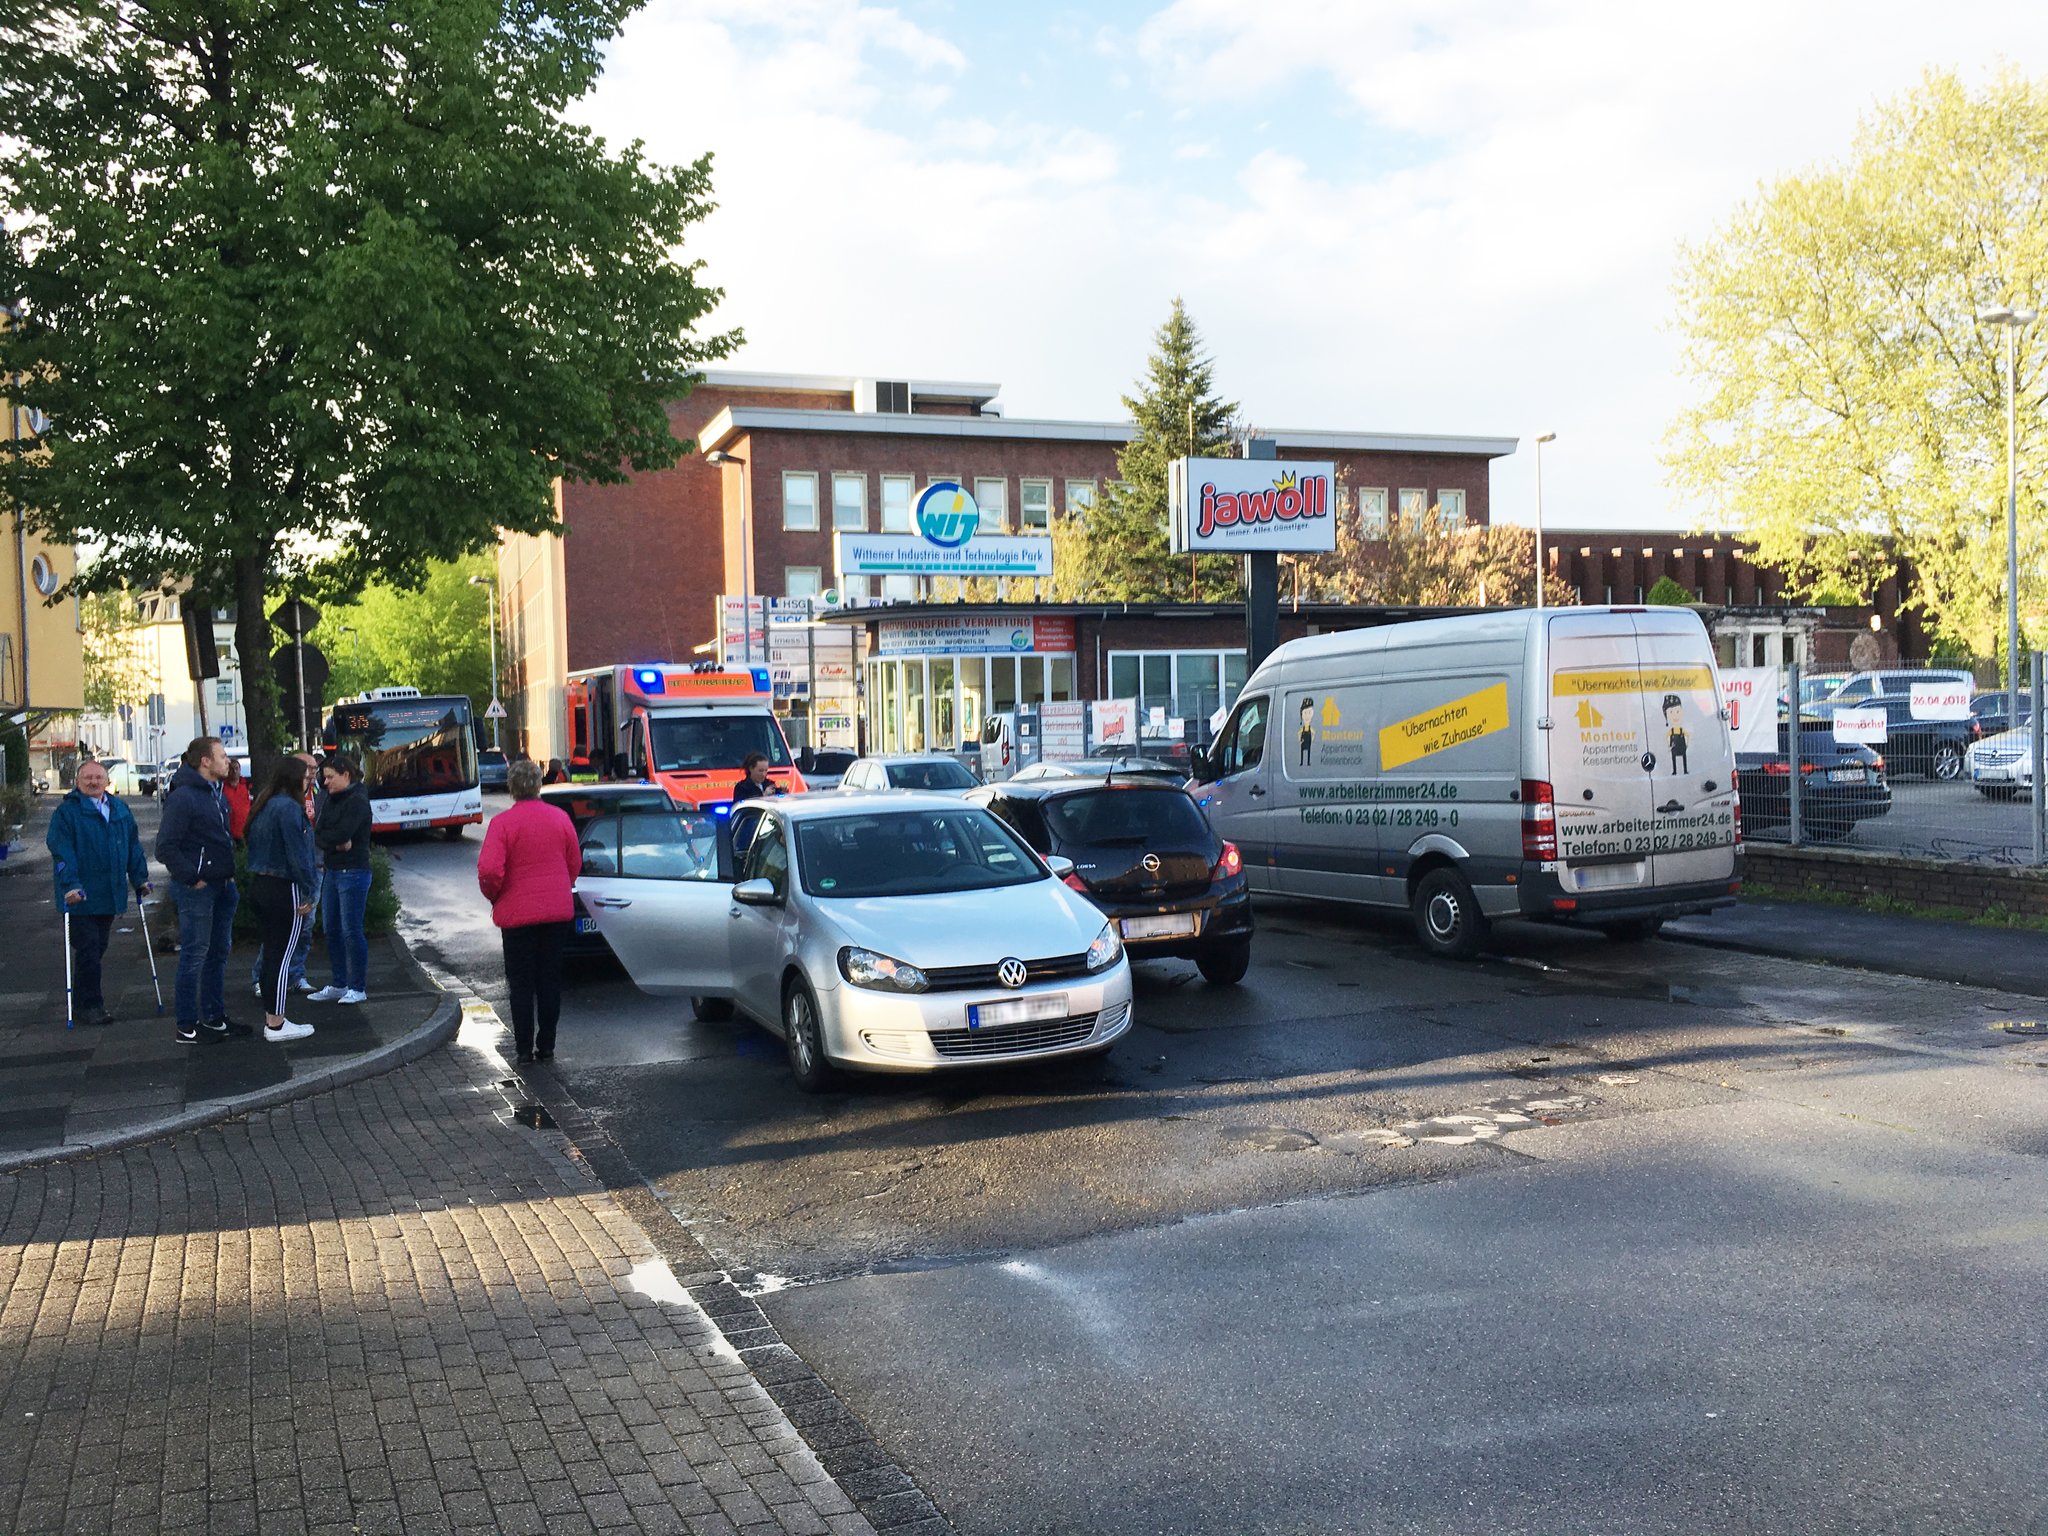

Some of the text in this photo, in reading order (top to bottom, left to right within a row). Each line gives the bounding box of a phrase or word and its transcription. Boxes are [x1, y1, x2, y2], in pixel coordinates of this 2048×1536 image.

[1197, 475, 1327, 538] jawoll
[852, 547, 1043, 565] Wittener Industrie und Technologie Park
[783, 599, 806, 609] HSG
[774, 615, 803, 624] SICK
[880, 616, 1031, 632] PROVISIONSFREIE VERMIETUNG
[935, 628, 990, 638] Gewerbepark
[1836, 720, 1885, 729] Demnächst
[1322, 730, 1364, 741] Monteur
[1423, 718, 1487, 754] wie Zuhause"
[1580, 731, 1637, 743] Monteur
[1582, 744, 1638, 755] Appartments
[1582, 754, 1639, 766] Kessenbrock
[1299, 782, 1458, 799] www.arbeiterzimmer24.de
[1299, 808, 1343, 825] Telefon:
[1345, 809, 1353, 825] 0
[1355, 809, 1370, 825] 23
[1372, 809, 1387, 826] 02
[1397, 809, 1412, 826] 28
[1415, 809, 1438, 827] 249
[1450, 809, 1459, 827] 0
[1561, 812, 1731, 836] www.arbeiterzimmer24.de
[1562, 841, 1620, 857] Telefon:
[1623, 837, 1632, 852] 0
[1635, 836, 1651, 852] 23
[1653, 835, 1669, 850] 02
[1679, 833, 1693, 848] 28
[1696, 831, 1717, 847] 249
[1725, 829, 1732, 844] 0
